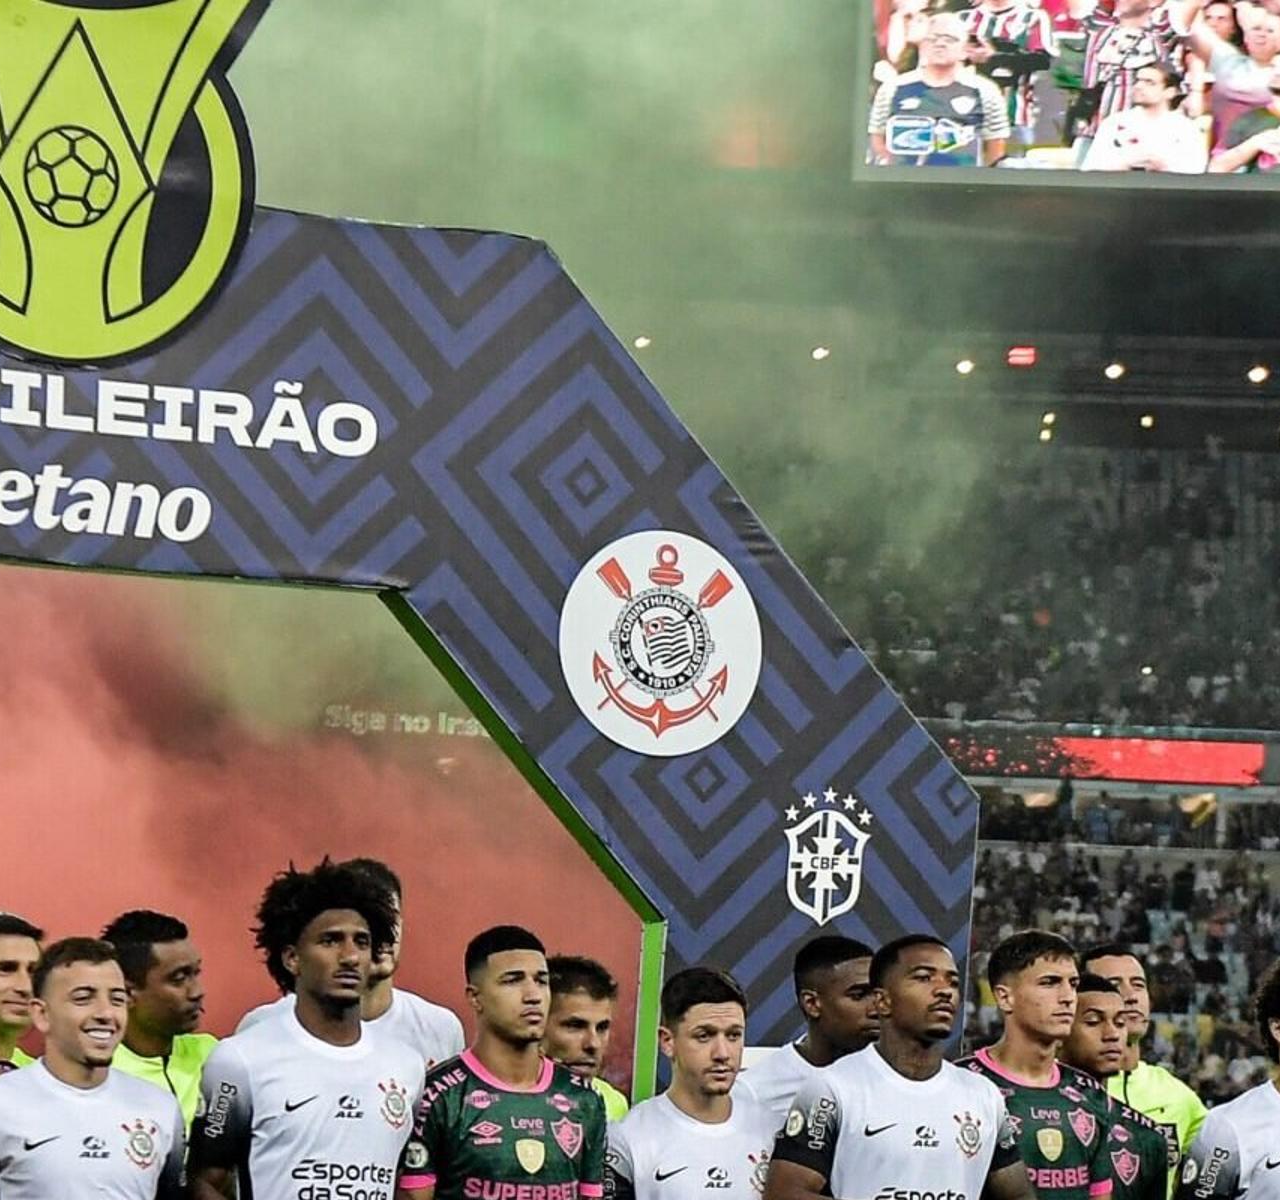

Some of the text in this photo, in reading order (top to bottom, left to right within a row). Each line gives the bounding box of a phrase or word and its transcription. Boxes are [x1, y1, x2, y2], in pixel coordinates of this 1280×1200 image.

[620, 596, 689, 642] CORINTHIANS
[686, 614, 706, 678] PAULISTA
[647, 677, 677, 689] 1910
[324, 704, 386, 735] Siga
[392, 711, 431, 733] no
[810, 857, 840, 870] CBF
[334, 1111, 364, 1119] ALE
[1030, 1106, 1061, 1121] Leve
[510, 1116, 545, 1130] Leve
[912, 1139, 940, 1148] ALE
[79, 1151, 110, 1159] ALE
[291, 1159, 393, 1185] Esportes
[704, 1181, 733, 1189] ALE
